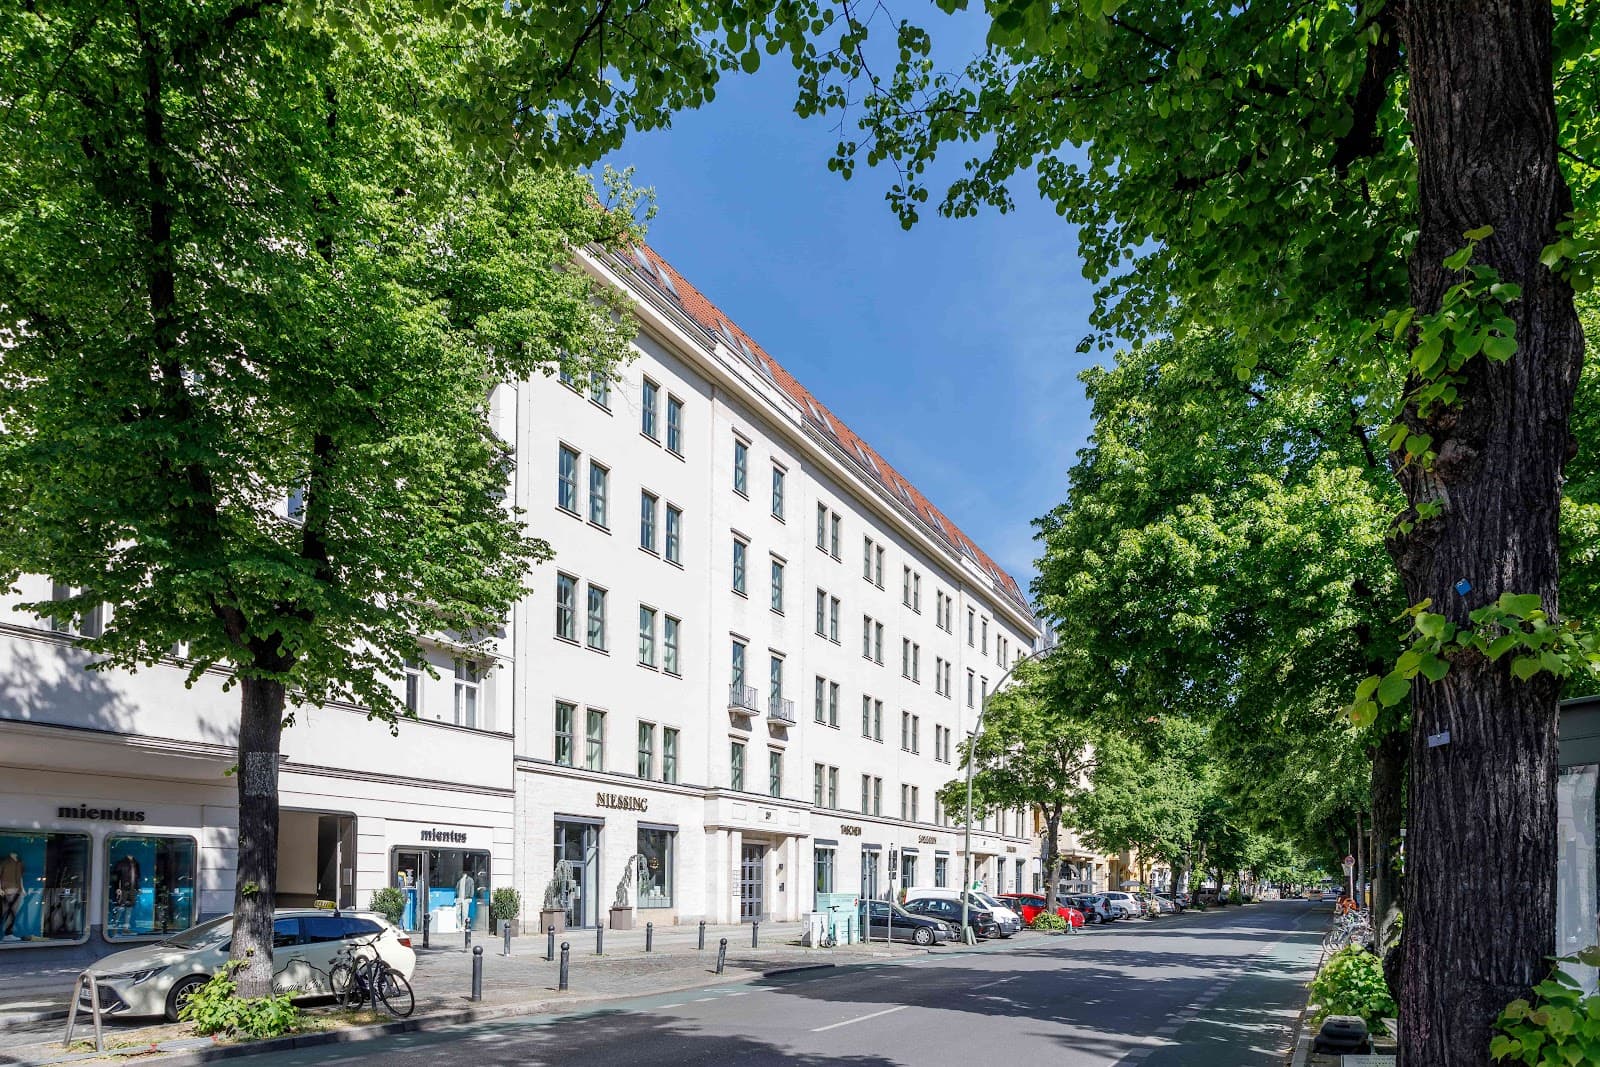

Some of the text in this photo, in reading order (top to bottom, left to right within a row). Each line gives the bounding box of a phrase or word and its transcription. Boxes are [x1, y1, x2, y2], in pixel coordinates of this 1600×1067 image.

[595, 792, 648, 812] NIESSING
[57, 803, 145, 822] mientus
[420, 828, 467, 844] mientus
